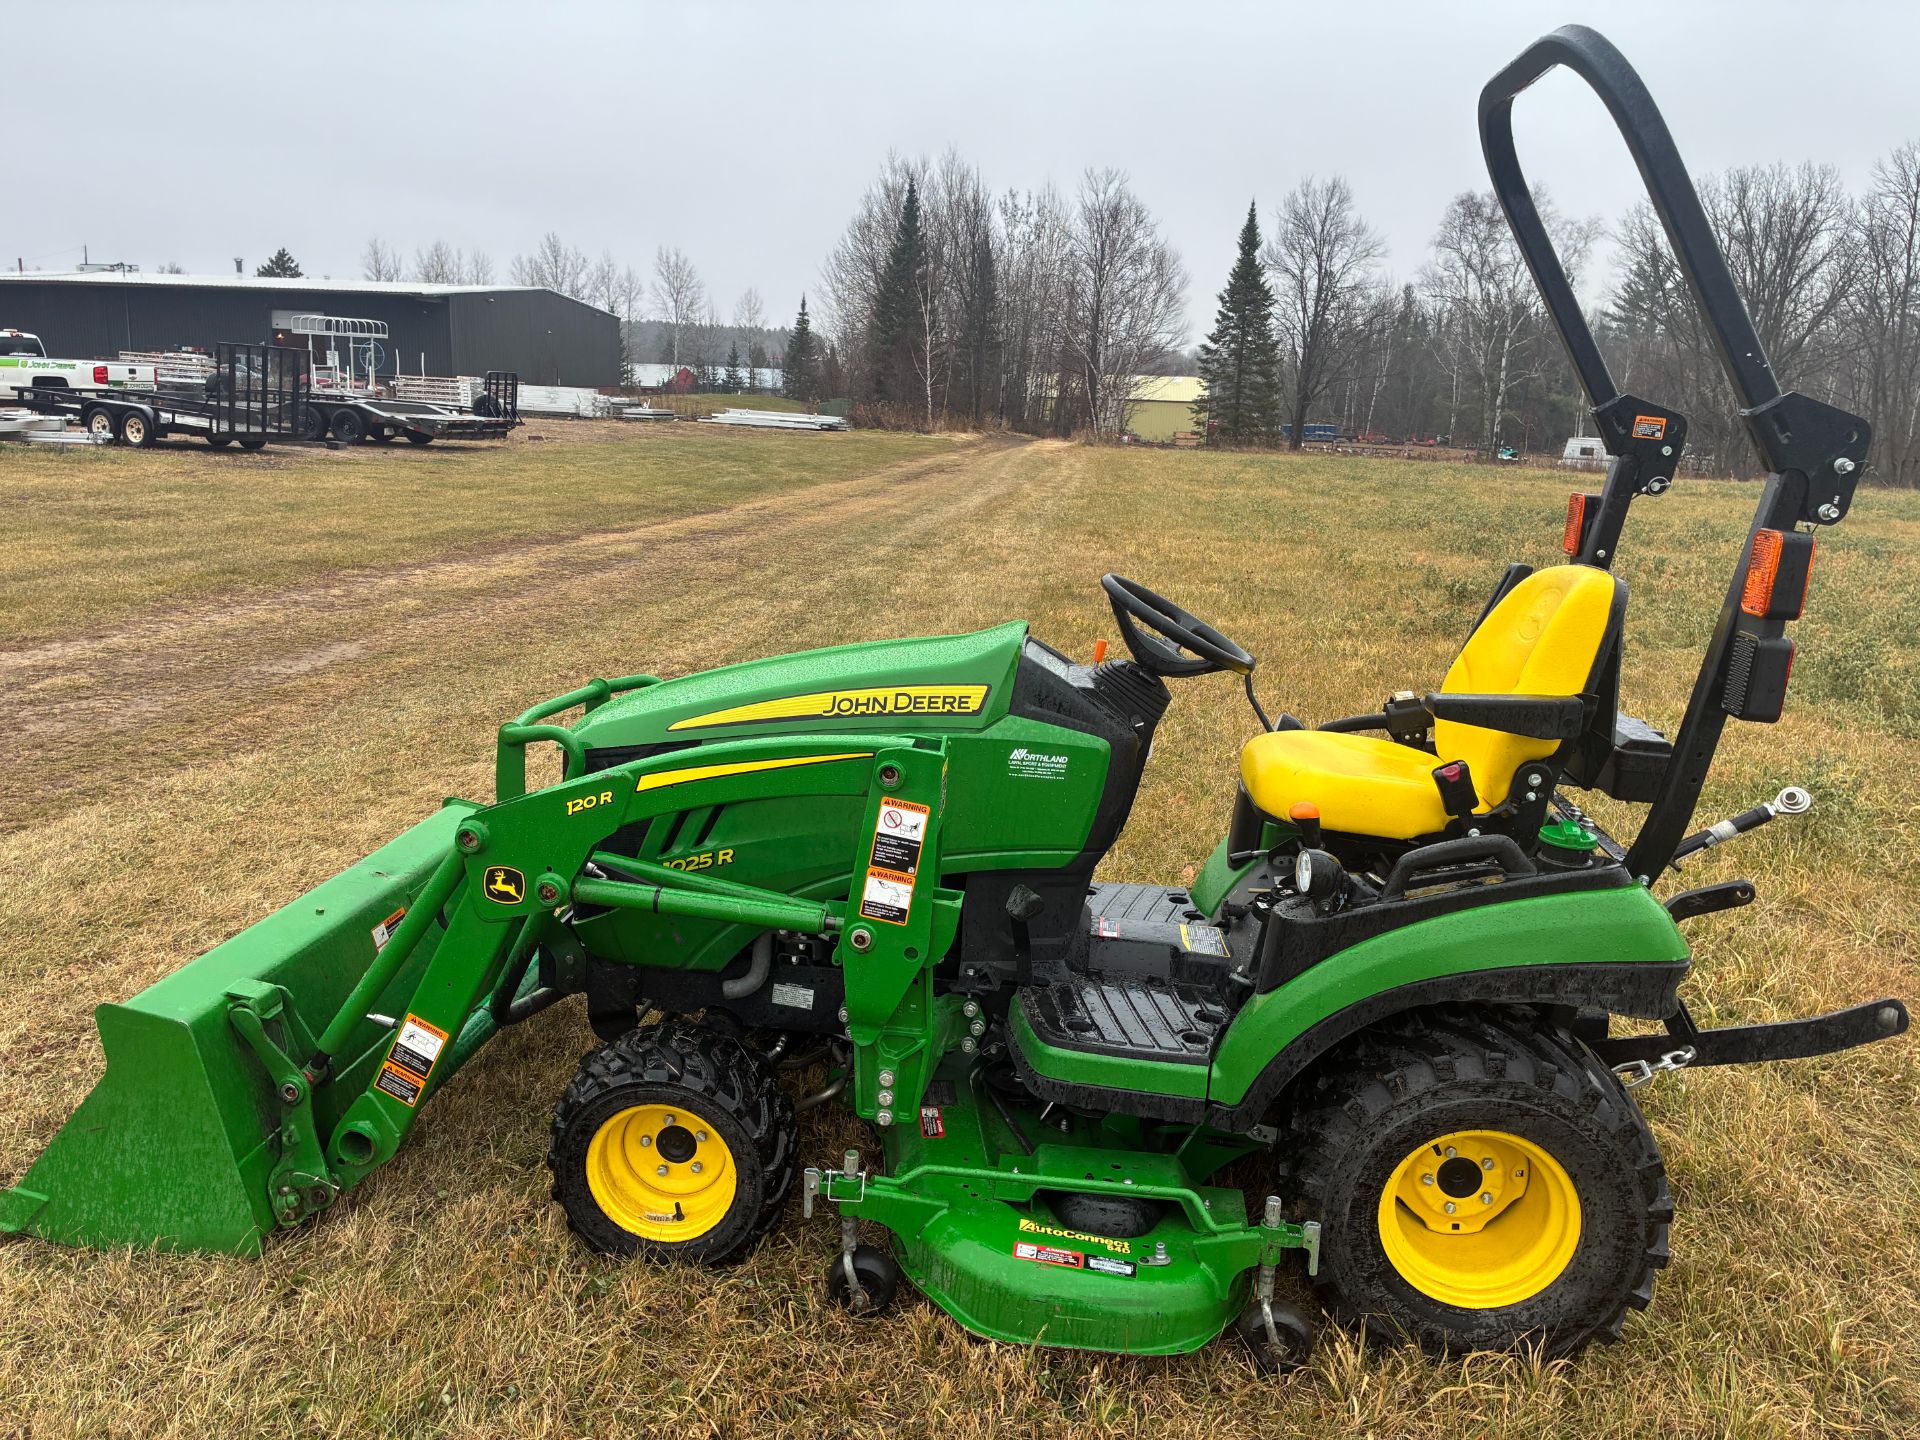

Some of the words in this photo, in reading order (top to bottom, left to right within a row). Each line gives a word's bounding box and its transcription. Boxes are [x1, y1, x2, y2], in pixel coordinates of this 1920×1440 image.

[823, 696, 888, 714] JOHN
[893, 693, 972, 711] DEERE
[1009, 749, 1068, 763] NORTHLAND
[566, 795, 598, 816] 120
[600, 791, 613, 806] R
[891, 799, 927, 813] WARNING
[717, 848, 734, 865] R
[877, 870, 913, 884] WARNING
[417, 1021, 444, 1038] WARNING
[394, 1068, 420, 1085] WARNING
[1021, 1220, 1130, 1248] AutoConnect
